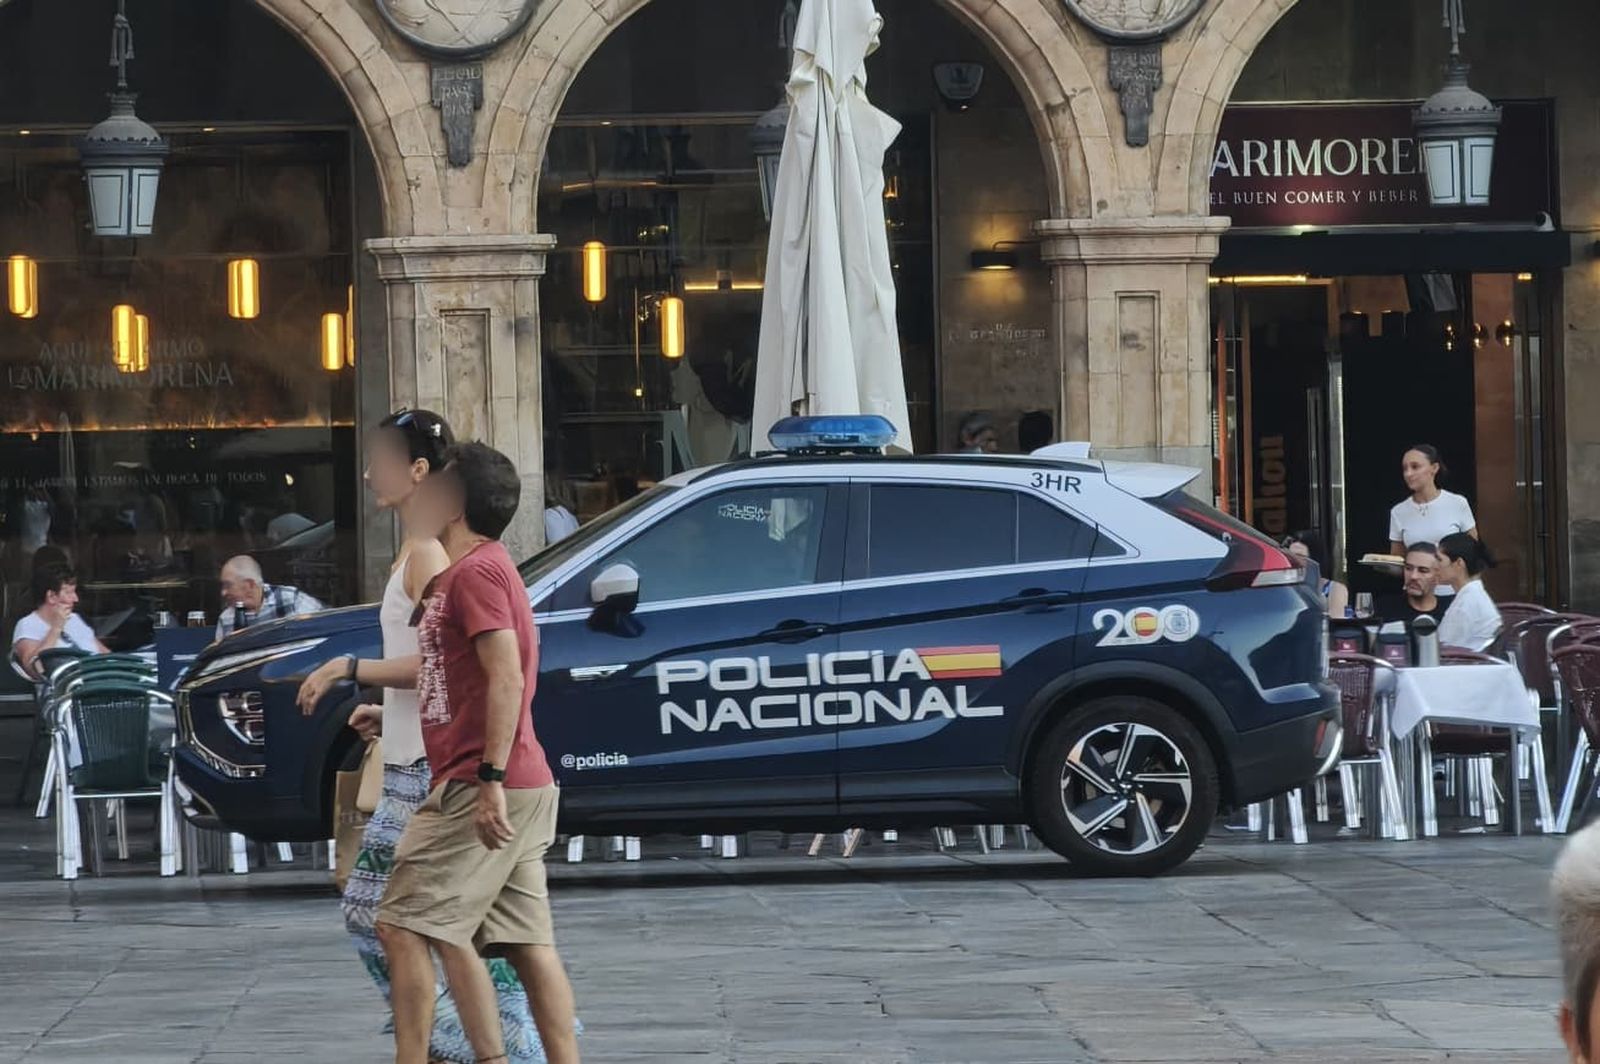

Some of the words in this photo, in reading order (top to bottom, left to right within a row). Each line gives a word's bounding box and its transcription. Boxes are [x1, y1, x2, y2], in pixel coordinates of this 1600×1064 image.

[1210, 138, 1424, 176] ARIMORE
[1233, 191, 1277, 204] BUEN
[1284, 190, 1346, 204] COMER
[1352, 190, 1361, 202] Y
[1369, 189, 1418, 202] BEBER
[1030, 471, 1082, 494] 3HR
[1092, 604, 1200, 647] 200
[660, 685, 1004, 734] NACIONAL
[560, 752, 629, 770] @policia
